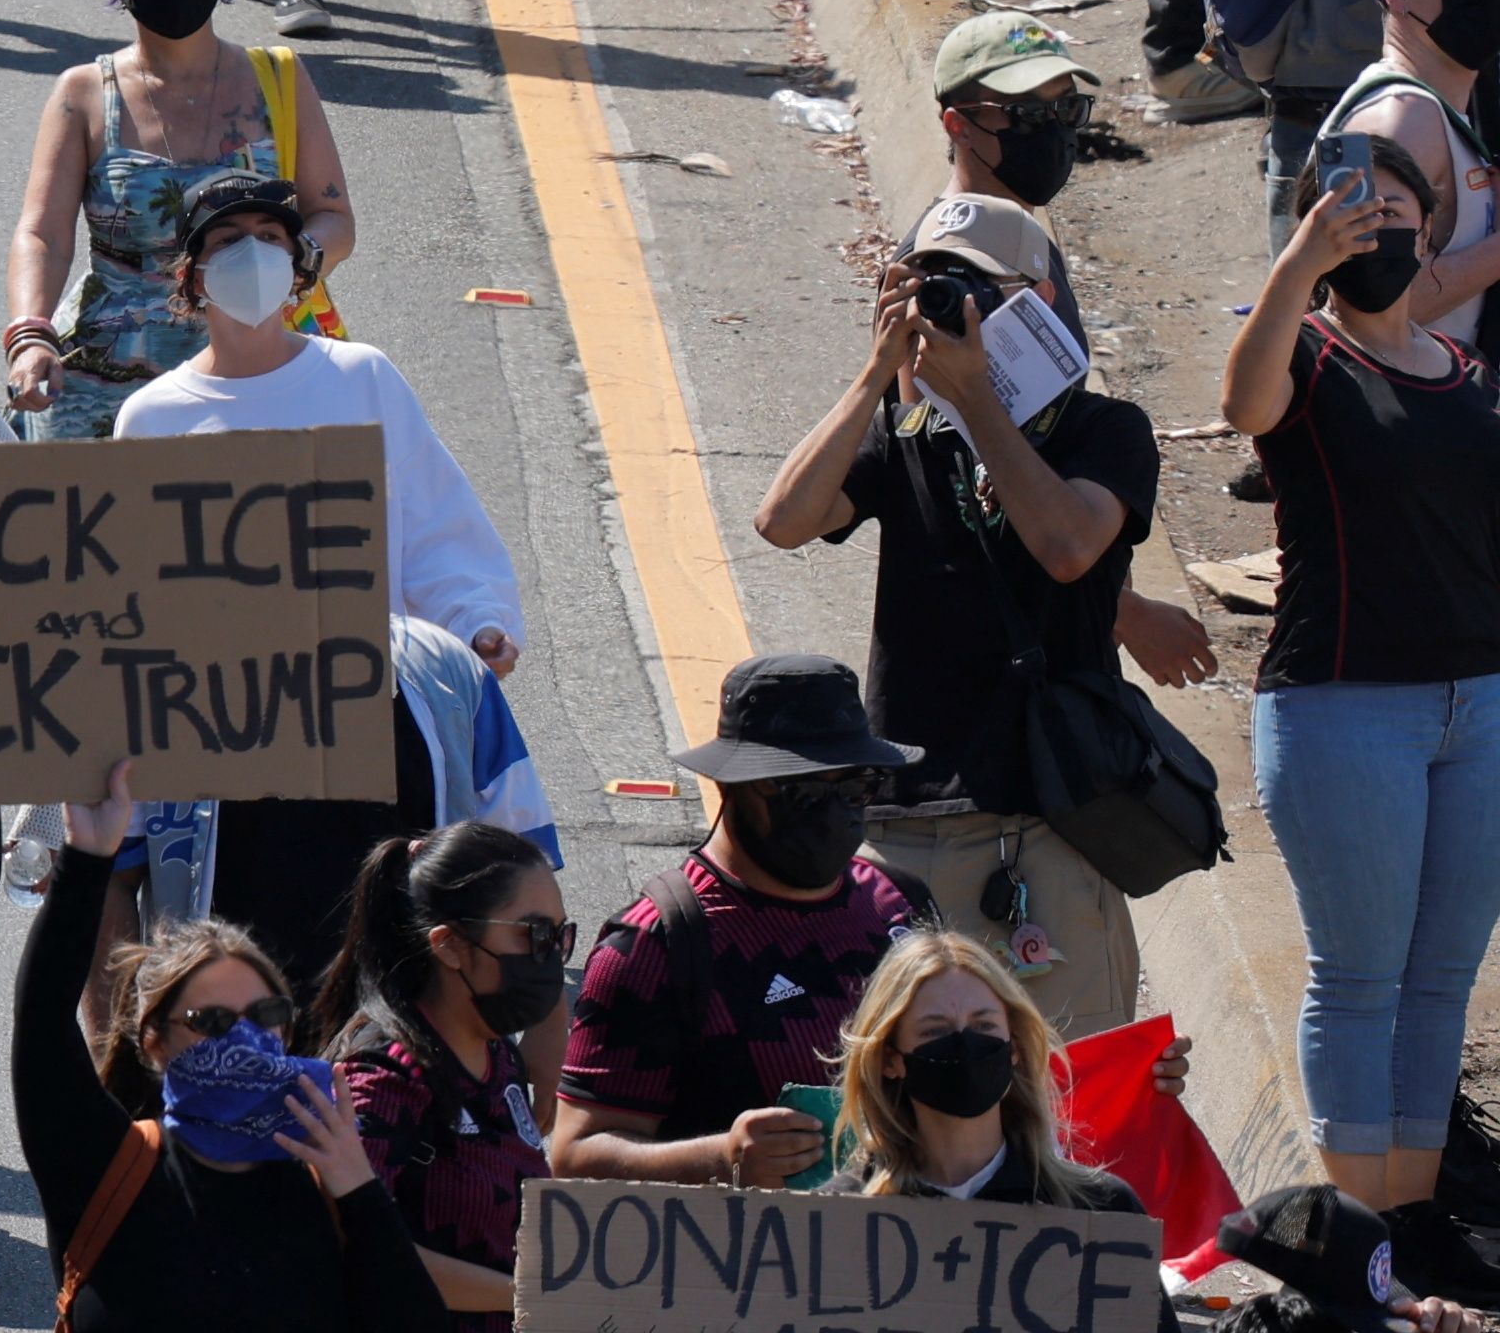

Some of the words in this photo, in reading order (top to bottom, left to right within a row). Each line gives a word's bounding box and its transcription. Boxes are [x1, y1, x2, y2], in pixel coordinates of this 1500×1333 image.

[152, 479, 378, 590] ICE
[34, 591, 145, 639] and
[99, 636, 386, 754] TRUMP
[765, 985, 806, 1006] adidas
[540, 1188, 920, 1319] DONALD
[961, 1219, 1155, 1333] ICE
